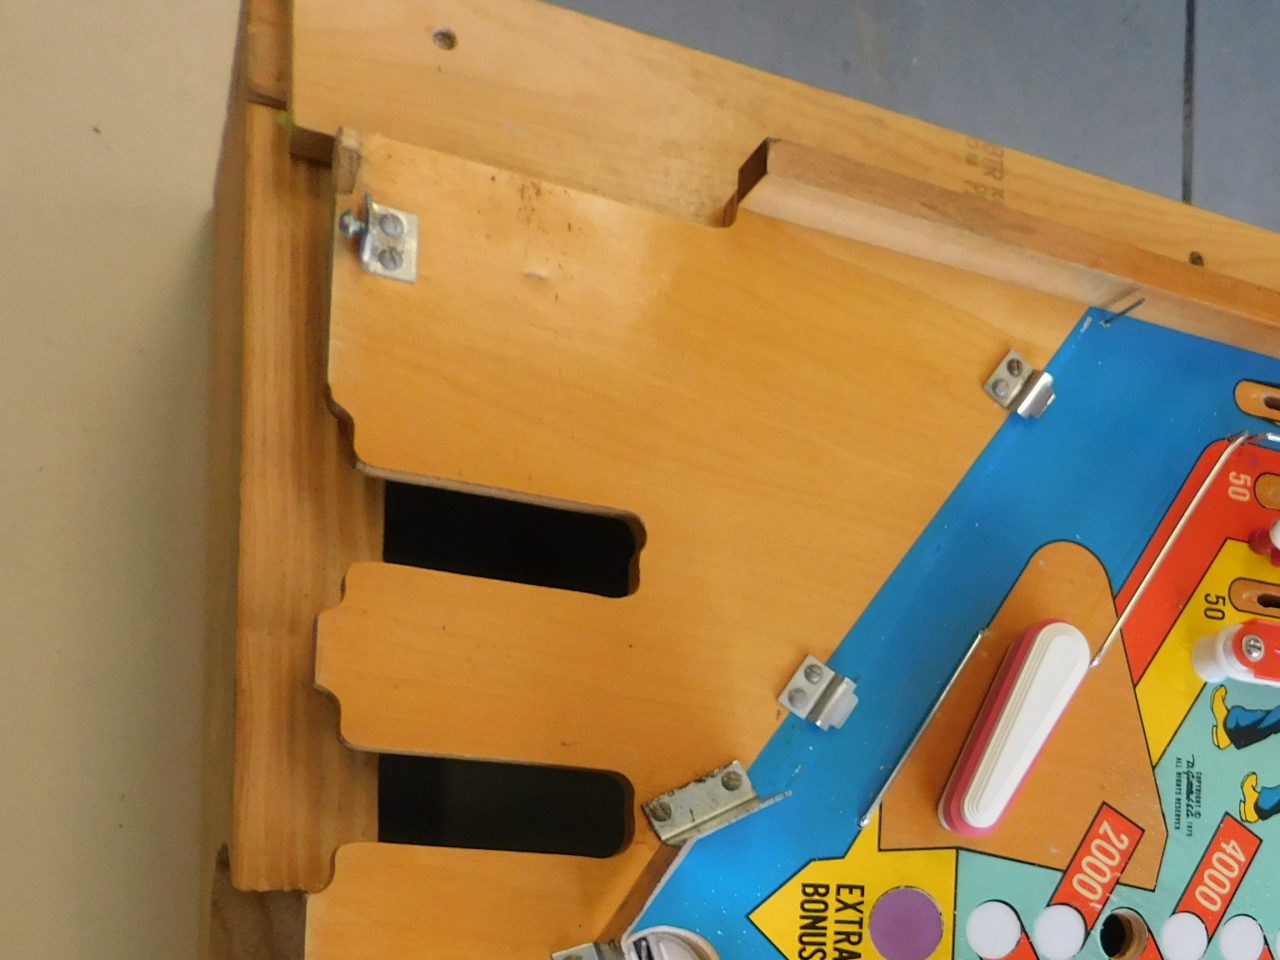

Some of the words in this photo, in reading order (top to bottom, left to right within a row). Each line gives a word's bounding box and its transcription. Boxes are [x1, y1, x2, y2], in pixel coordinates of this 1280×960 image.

[1227, 471, 1251, 502] 50
[1204, 593, 1226, 621] 50
[1073, 826, 1129, 898] 2000
[1195, 838, 1246, 912] 4000
